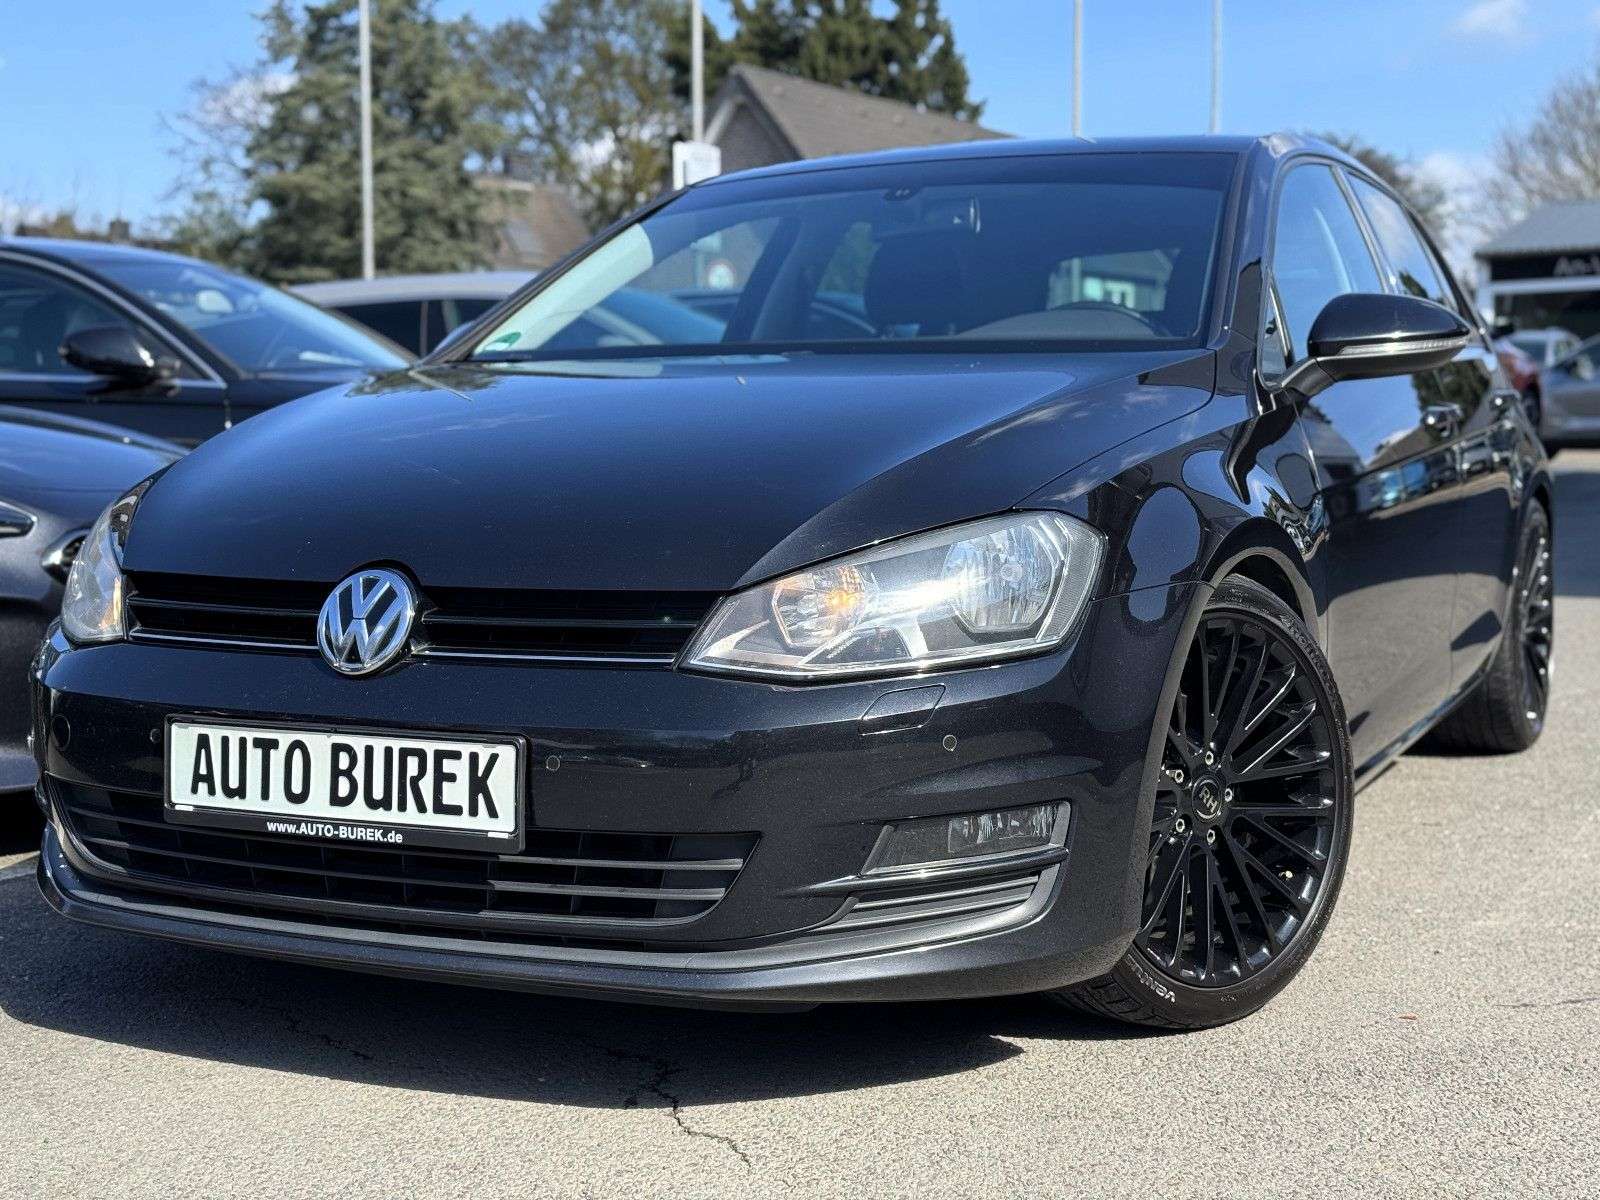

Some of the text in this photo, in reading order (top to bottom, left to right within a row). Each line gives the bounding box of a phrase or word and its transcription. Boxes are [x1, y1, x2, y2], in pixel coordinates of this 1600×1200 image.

[319, 570, 412, 674] VW
[190, 733, 500, 819] AUTO BUREK
[266, 820, 403, 844] www.AUTO-BUREK.de
